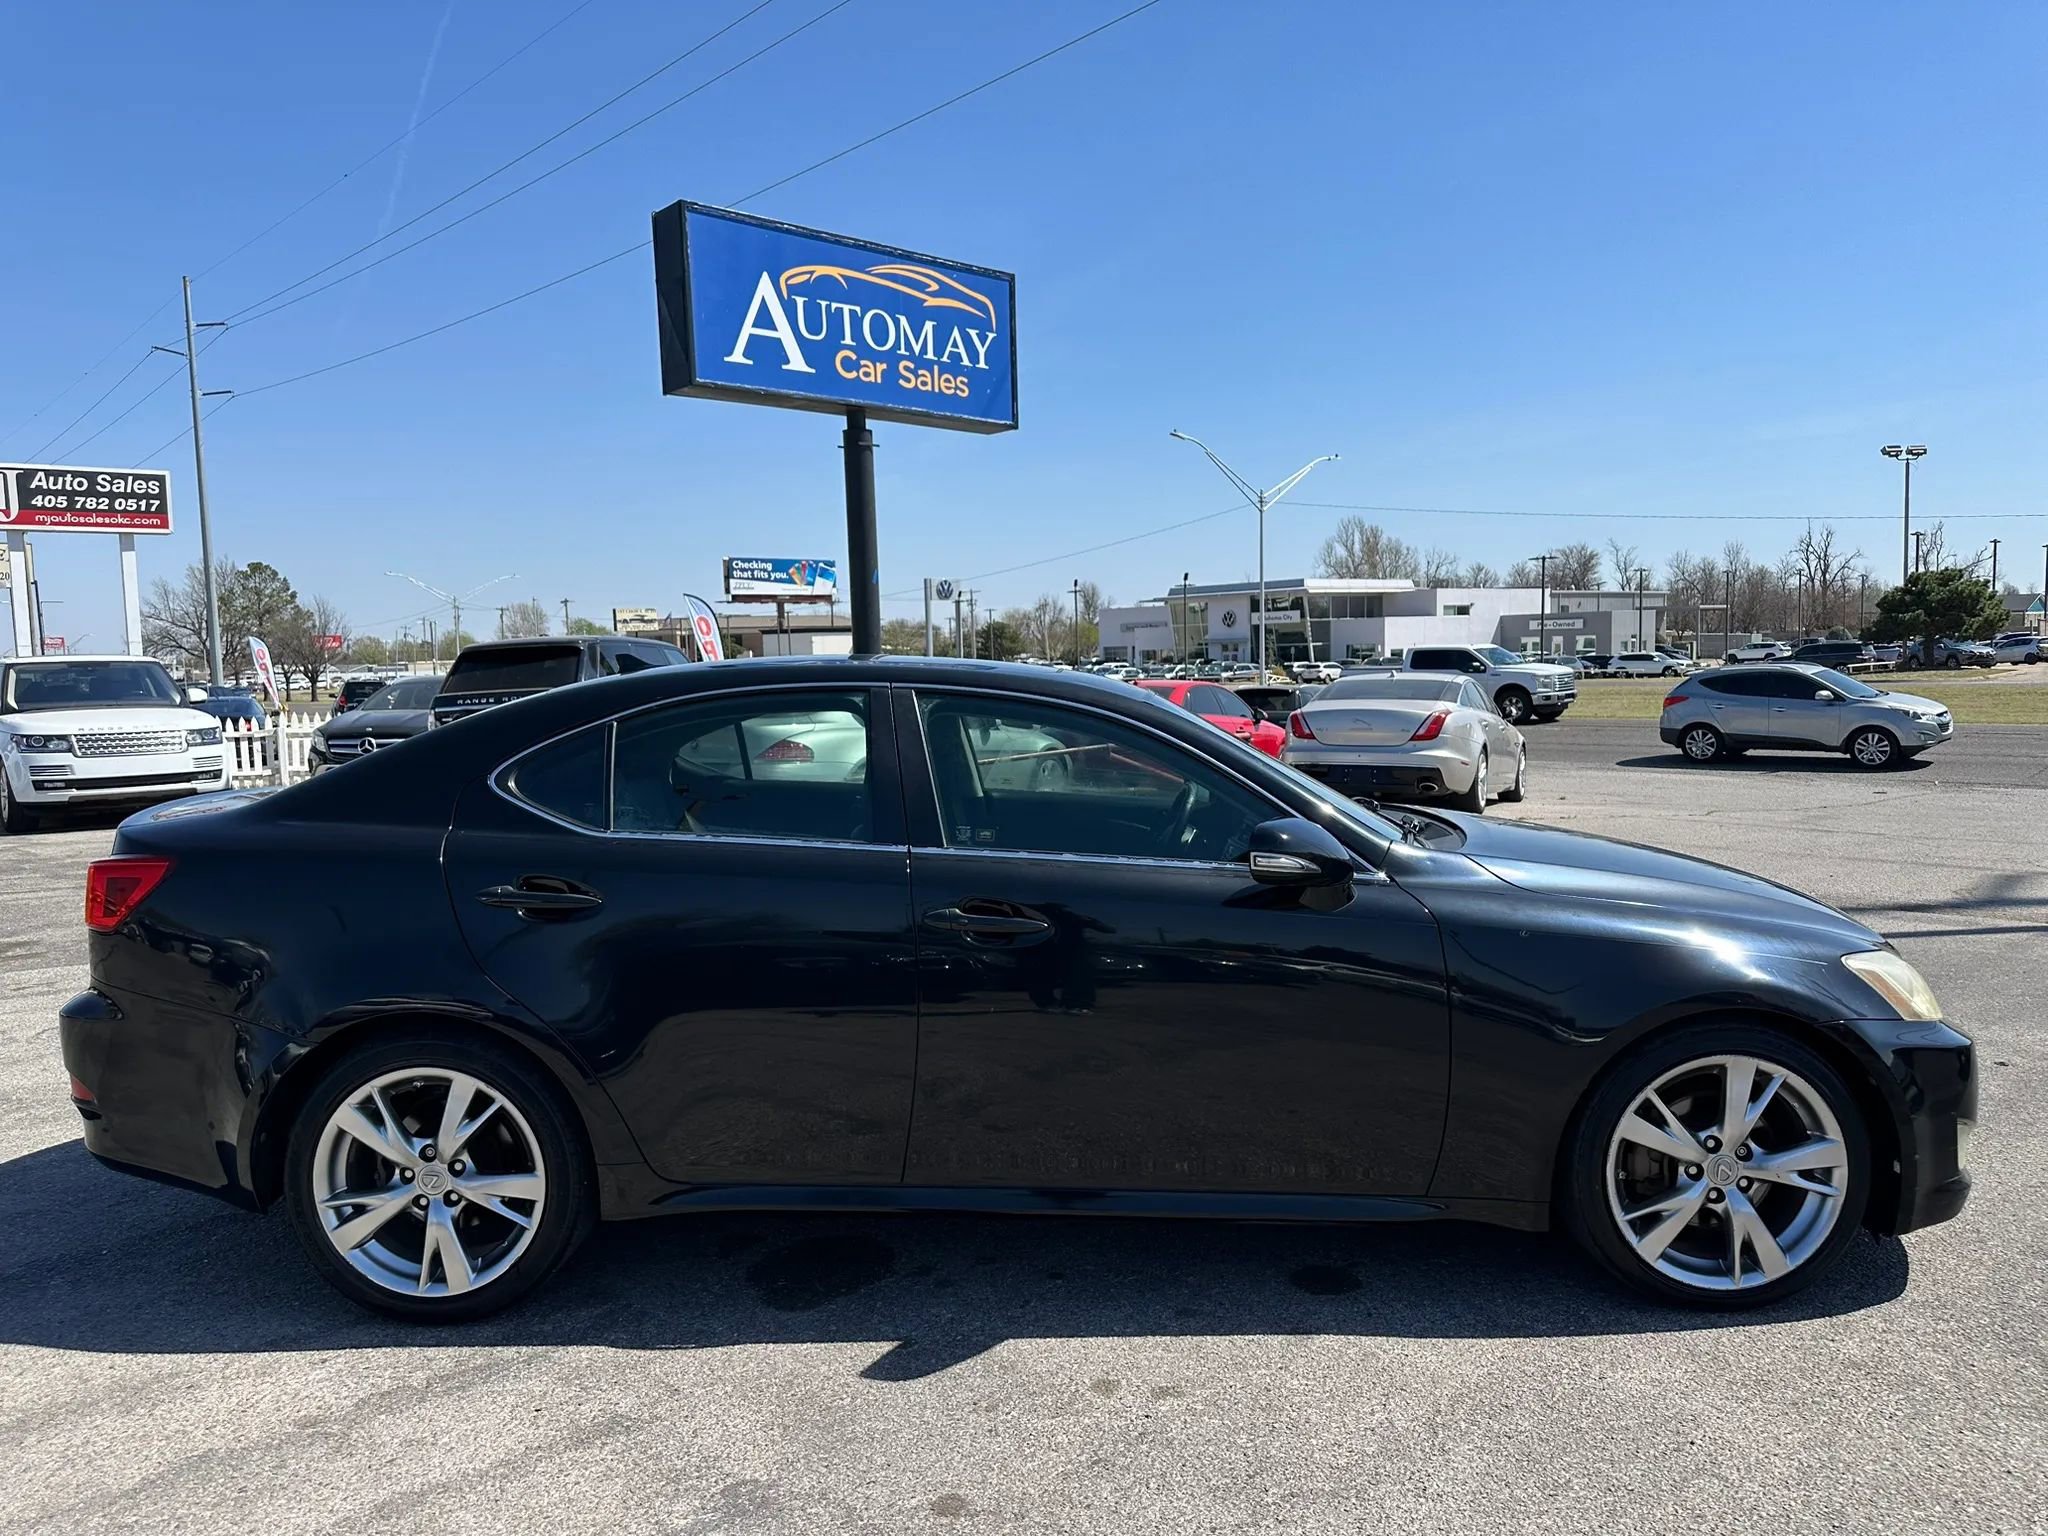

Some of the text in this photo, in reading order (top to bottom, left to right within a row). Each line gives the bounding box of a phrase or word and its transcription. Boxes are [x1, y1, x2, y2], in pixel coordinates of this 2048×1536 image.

[835, 350, 970, 398] Car Sales
[29, 471, 160, 494] Auto Sales
[31, 495, 161, 512] 405 782 0517
[35, 512, 161, 526] mjautosalesokc.com
[732, 560, 773, 571] Checking
[732, 570, 753, 578] that
[754, 570, 769, 578] fits
[457, 697, 495, 705] RANGE
